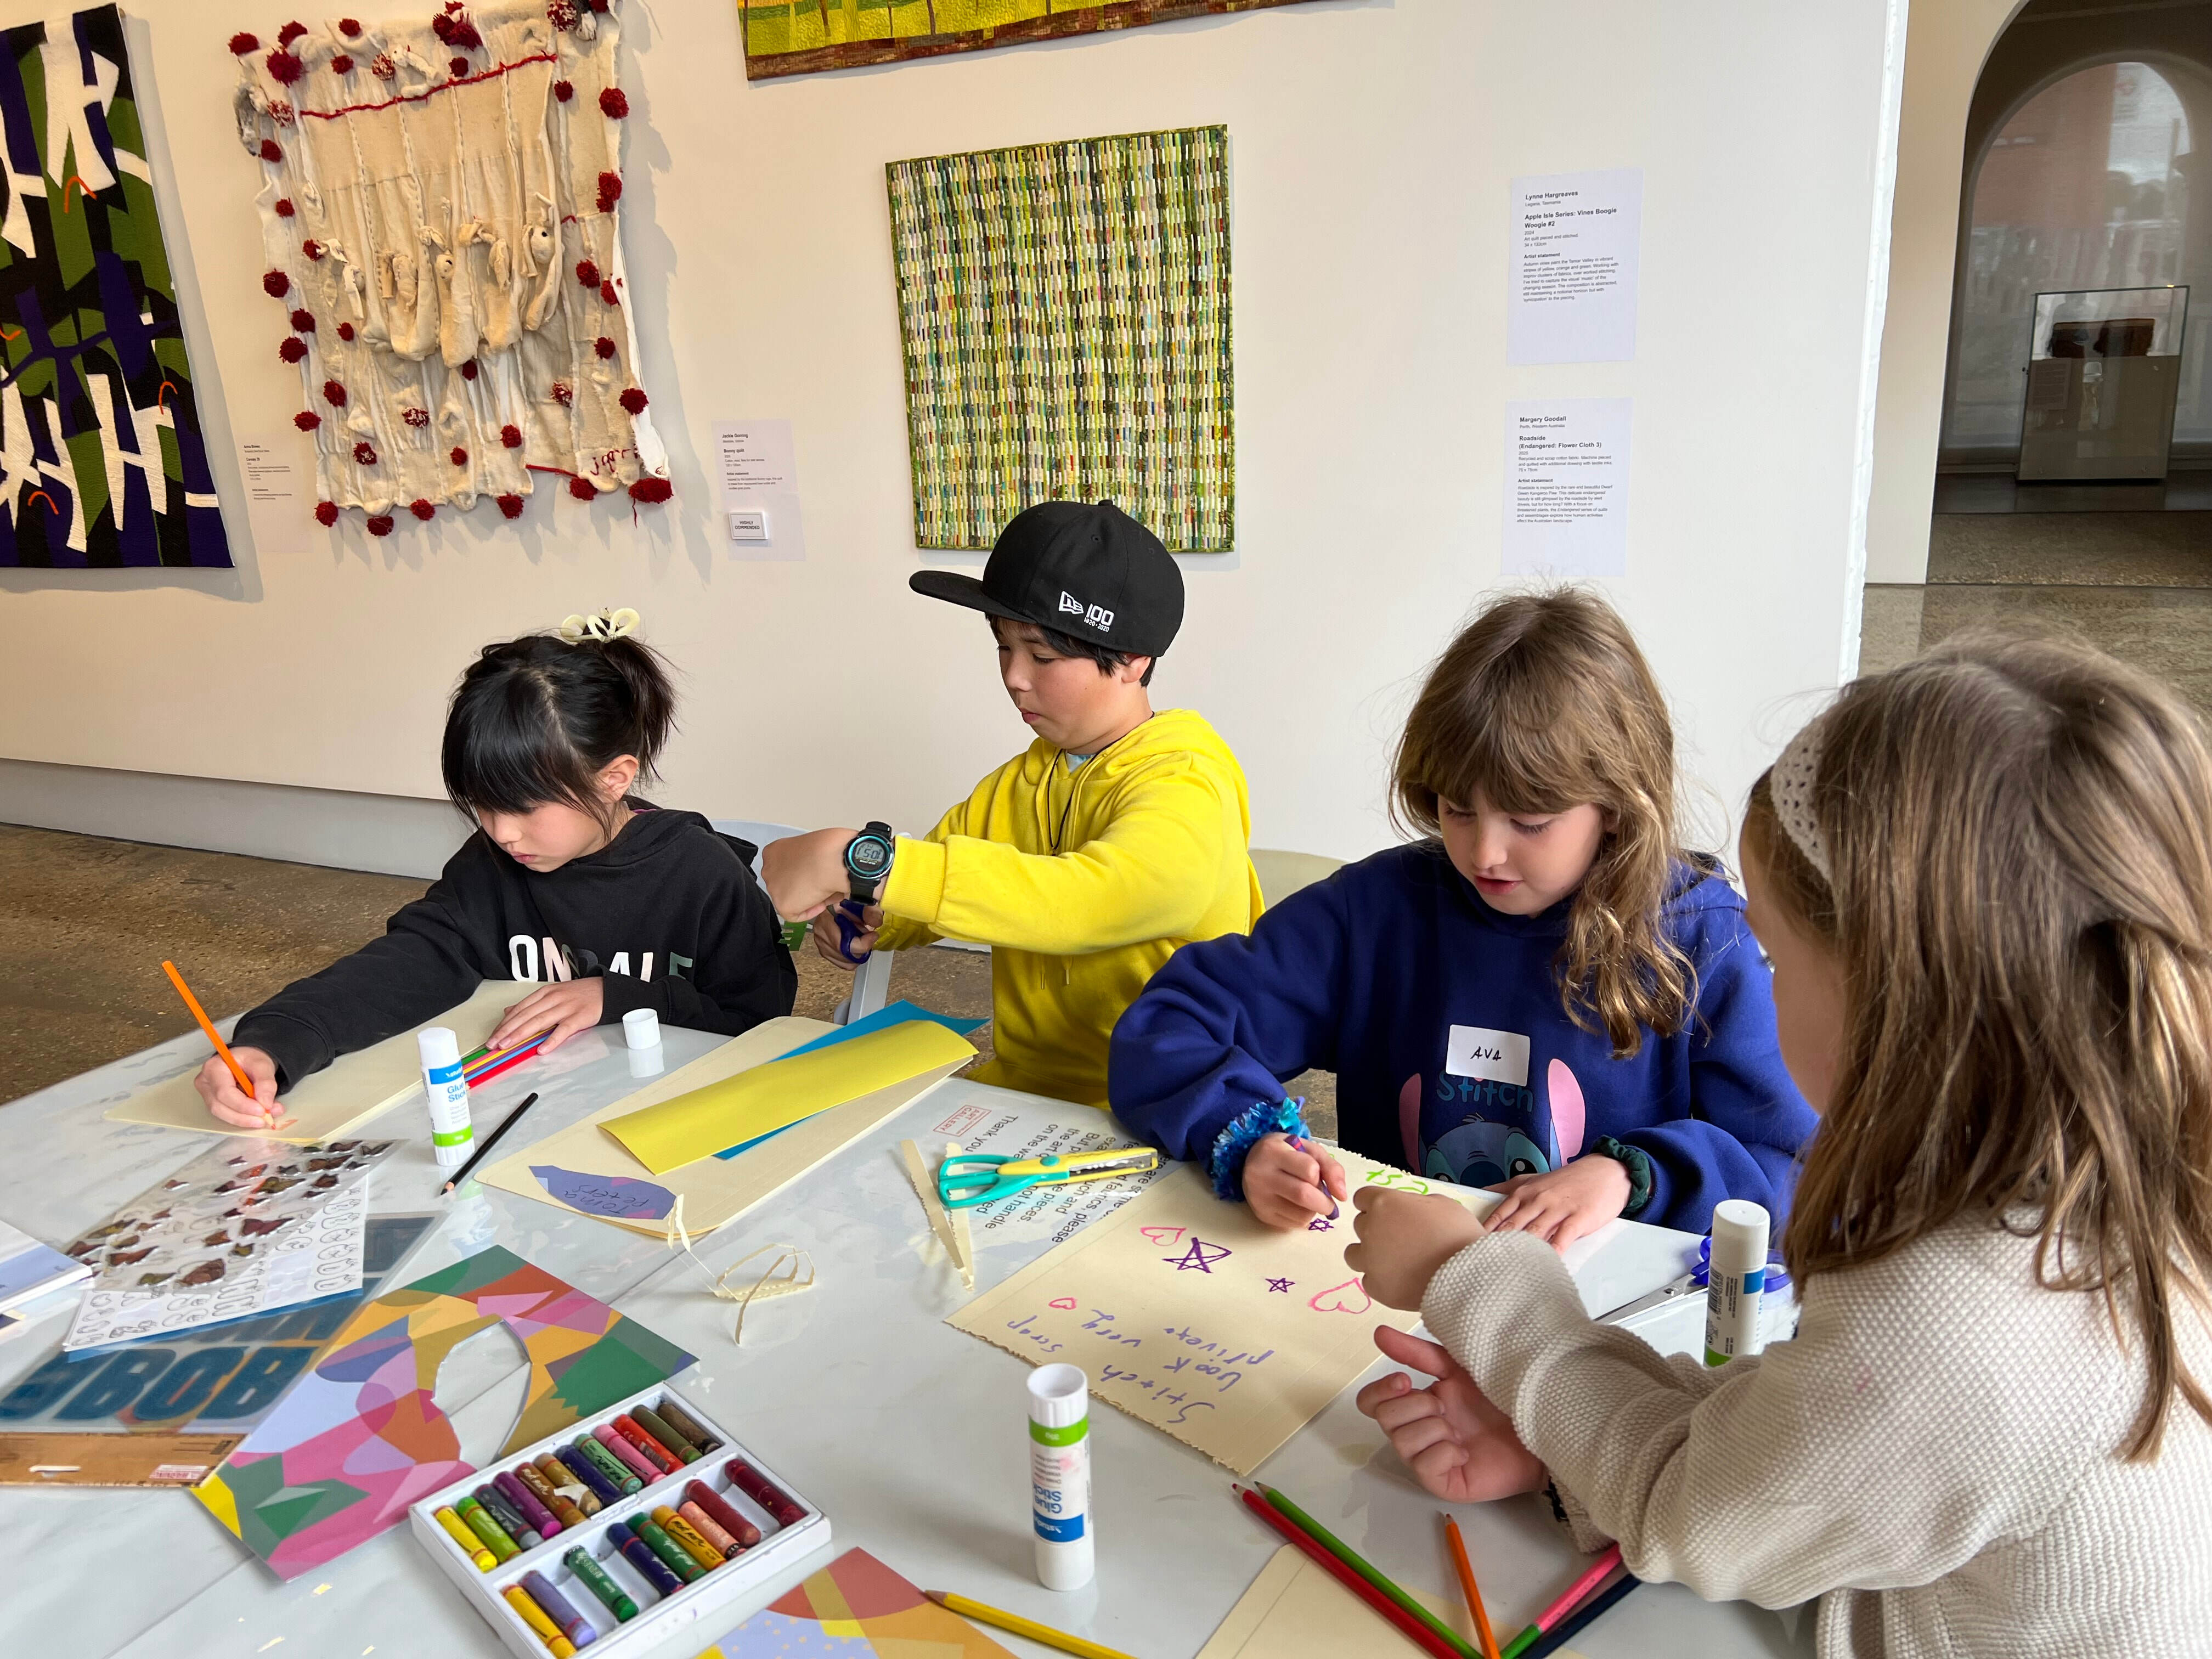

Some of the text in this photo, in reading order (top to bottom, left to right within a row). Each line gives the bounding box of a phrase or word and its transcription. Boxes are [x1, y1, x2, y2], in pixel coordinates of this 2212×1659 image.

[1086, 603, 1114, 627] 100
[1470, 1046, 1502, 1062] AVA
[447, 1081, 464, 1094] Glue
[939, 1107, 972, 1131] GALLERY
[964, 1108, 980, 1120] ART
[982, 1115, 1019, 1137] Thank
[1042, 1124, 1058, 1134] on
[1028, 1135, 1048, 1147] the
[1059, 1128, 1080, 1141] the
[1077, 1132, 1101, 1146] But
[964, 1136, 988, 1152] you
[1045, 1141, 1063, 1152] art
[1138, 1170, 1157, 1184] are
[1017, 1185, 1039, 1200] not
[1017, 1192, 1055, 1222] pieces.
[1055, 1196, 1077, 1215] and
[985, 1199, 1026, 1229] handle
[1051, 1212, 1088, 1243] please
[1098, 1363, 1216, 1424] Stitch
[1035, 1495, 1062, 1514] Glue
